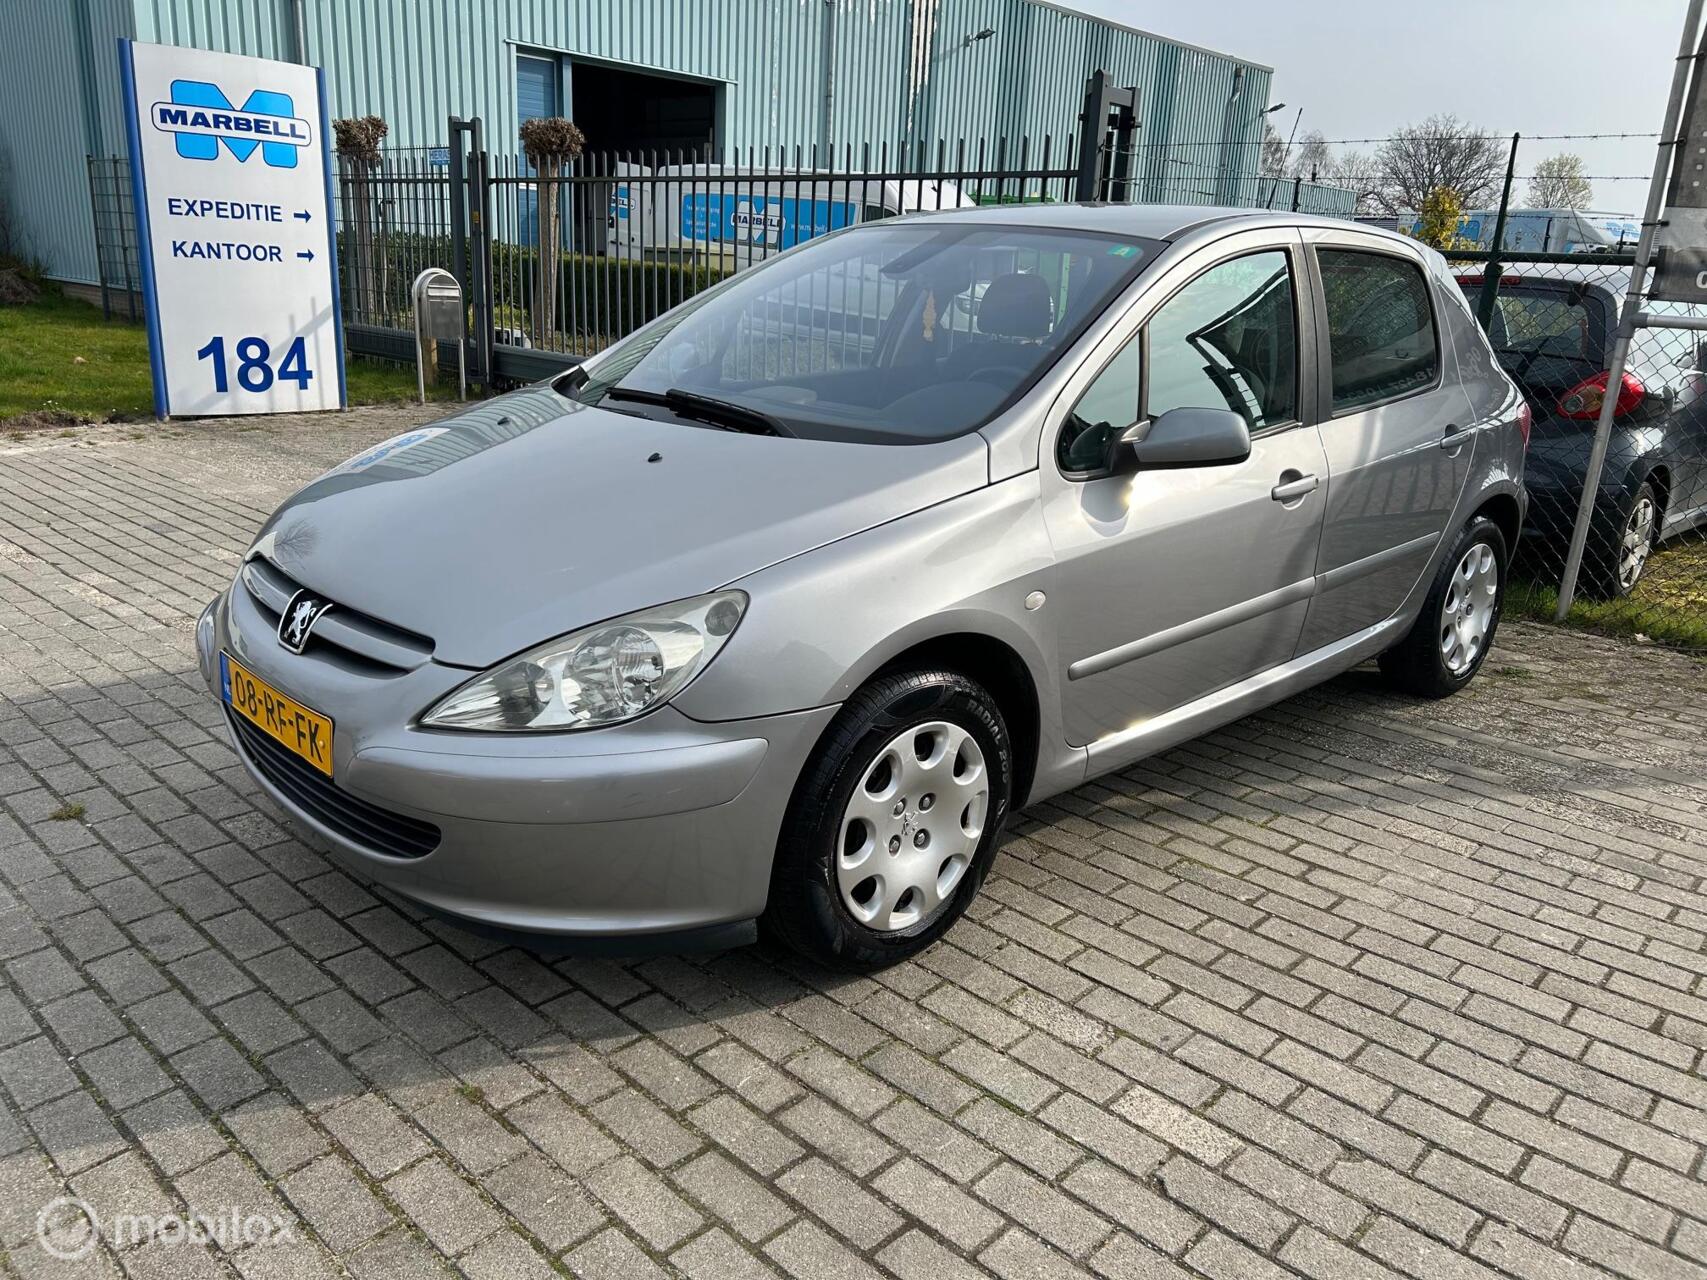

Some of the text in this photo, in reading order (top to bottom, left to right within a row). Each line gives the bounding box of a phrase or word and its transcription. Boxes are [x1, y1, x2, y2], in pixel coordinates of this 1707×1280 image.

[159, 108, 306, 140] MARBELL
[167, 198, 283, 222] EXPEDITIE
[172, 240, 283, 262] KANTOOR
[197, 336, 314, 393] 184
[235, 670, 324, 764] 08-RF-FK
